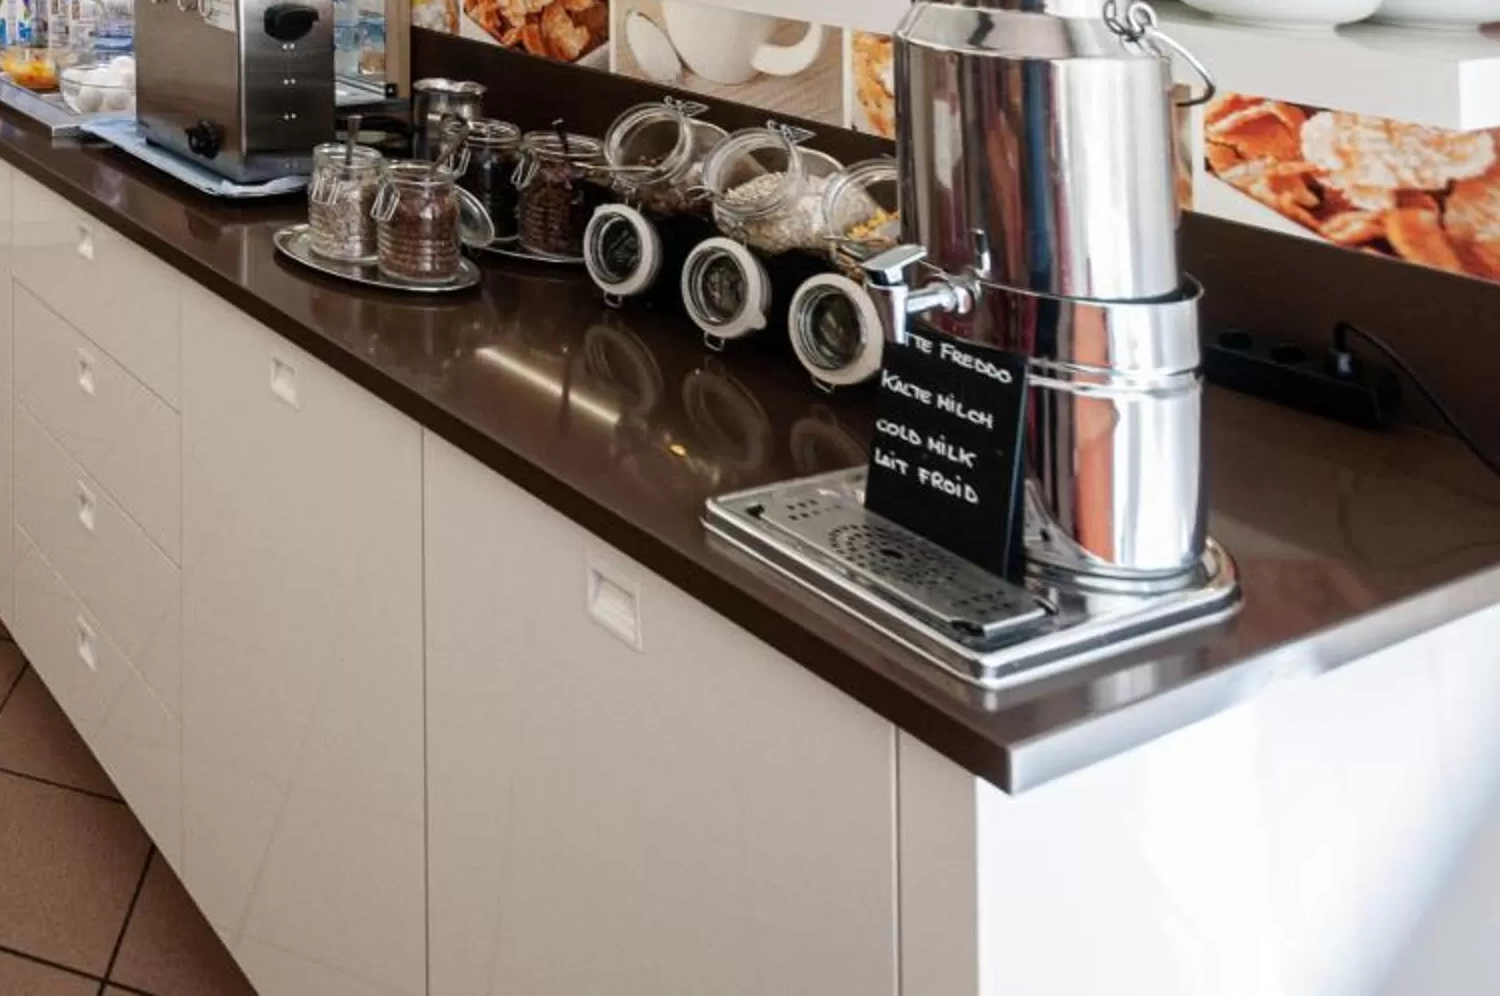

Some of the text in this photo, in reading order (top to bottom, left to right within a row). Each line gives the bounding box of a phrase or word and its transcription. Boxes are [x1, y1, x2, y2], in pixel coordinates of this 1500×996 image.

[940, 343, 1012, 383] FREDDO
[881, 368, 932, 405] KALTE
[875, 418, 921, 445] COLD
